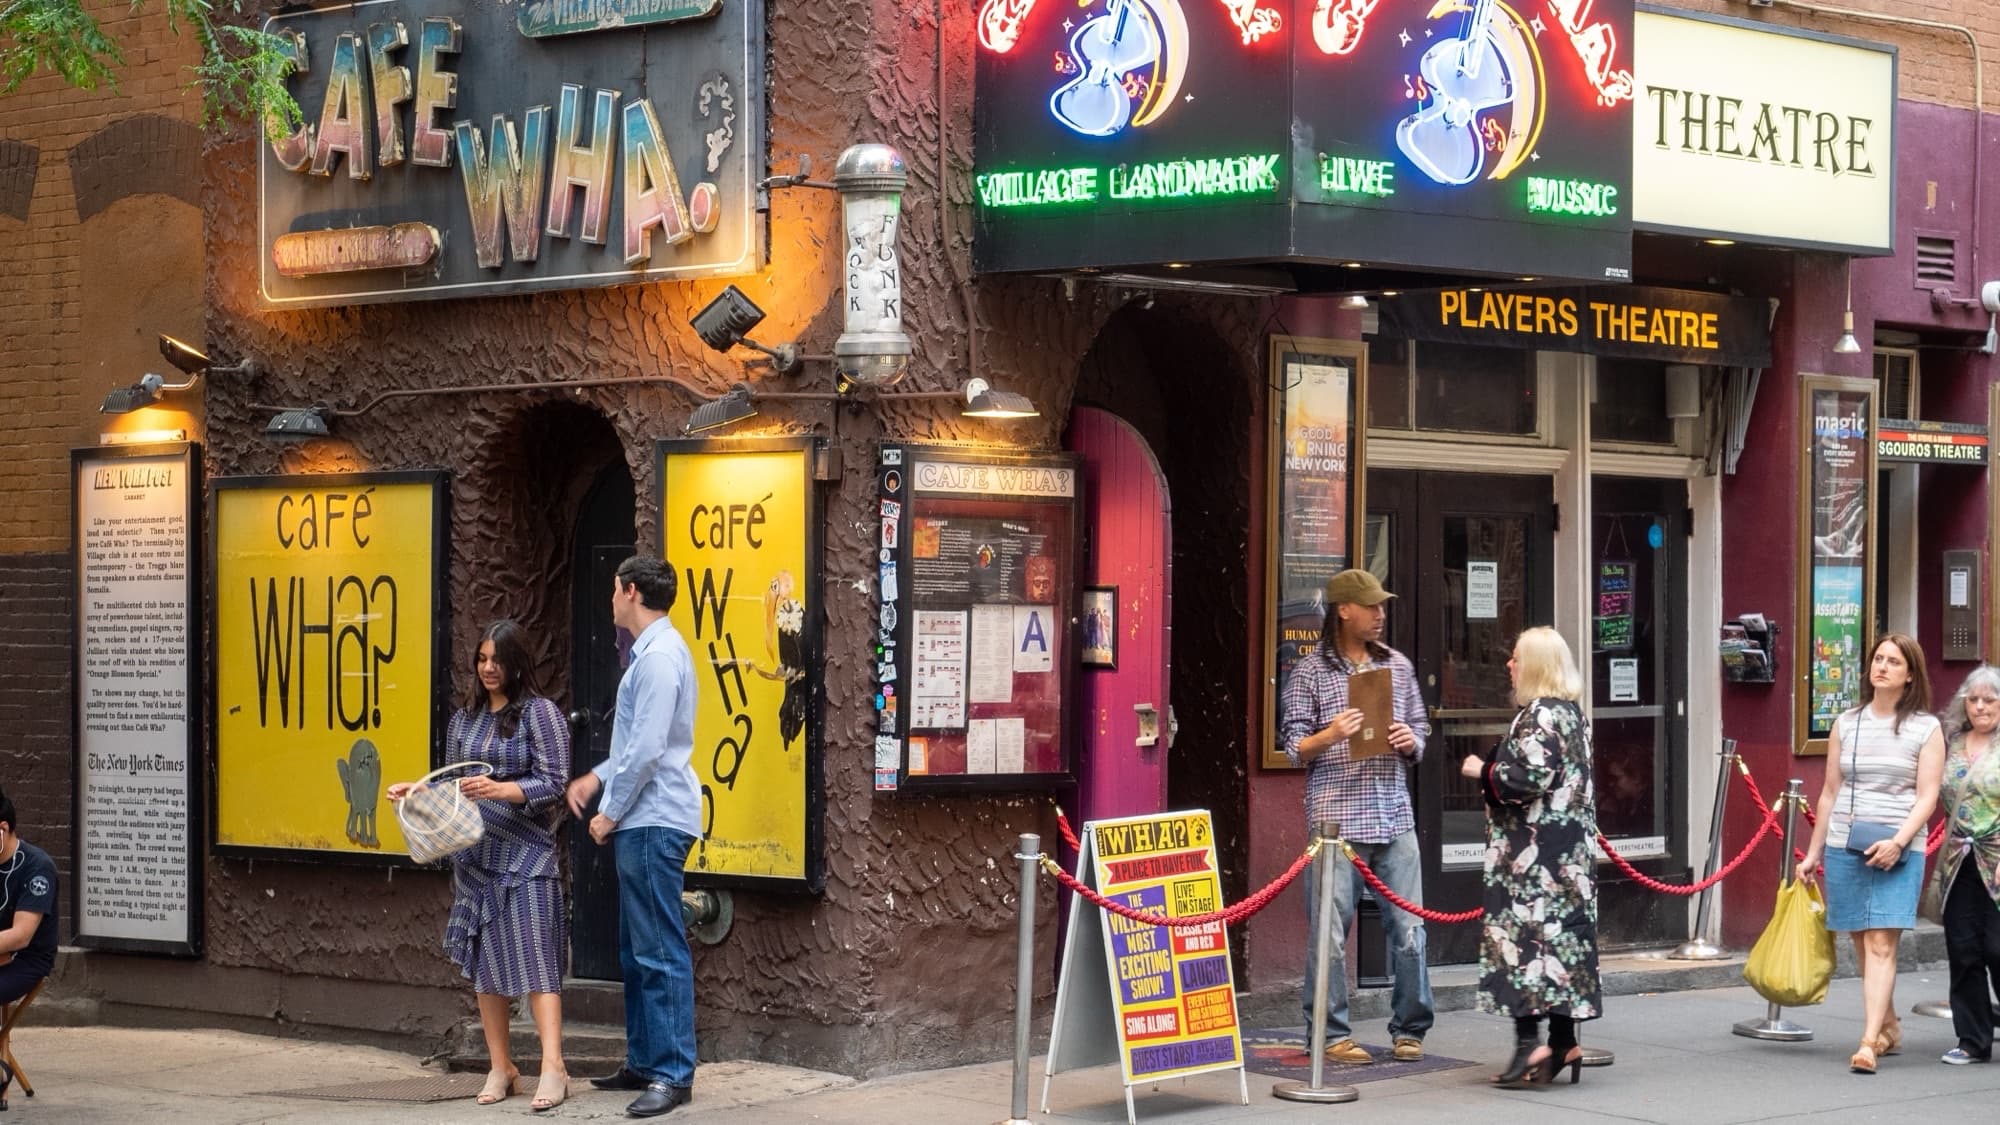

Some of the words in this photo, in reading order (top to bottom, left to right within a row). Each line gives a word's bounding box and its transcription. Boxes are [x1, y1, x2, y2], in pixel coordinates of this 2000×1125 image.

[264, 16, 464, 180] CAFE
[1647, 85, 1873, 176] THEATRE
[977, 167, 1098, 207] VILLAGE
[1110, 154, 1280, 198] LANDMARK
[1321, 156, 1395, 194] LIVE
[877, 214, 899, 319] FUNK
[1441, 290, 1578, 336] PLAYERS
[1590, 302, 1719, 349] THEATRE
[1300, 427, 1333, 440] GOOD
[1815, 412, 1865, 438] magic
[1879, 441, 1931, 457] SGOUROS
[1934, 445, 1981, 459] THEATRE
[1286, 457, 1313, 470] NEW
[1314, 458, 1346, 472] YORK
[919, 464, 989, 489] CAFE
[995, 467, 1070, 493] WHA?
[1021, 611, 1047, 652] A
[1285, 630, 1322, 641] HUMAN
[88, 752, 105, 772] The
[107, 753, 127, 771] New
[129, 754, 153, 776] York
[154, 754, 185, 772] Times
[1105, 820, 1187, 855] WHA?
[1115, 865, 1121, 881] A
[1121, 861, 1149, 880] PLACE
[1150, 858, 1162, 876] TO
[1162, 854, 1185, 873] HAVE
[1128, 894, 1143, 908] THE
[1177, 884, 1195, 899] LIVE!
[1178, 899, 1188, 914] ON
[1189, 897, 1212, 912] STAGE
[1127, 931, 1156, 954] MOST
[1185, 937, 1201, 951] AND
[1120, 949, 1170, 980] EXCITING
[1181, 959, 1227, 988] LAUGH!
[1131, 975, 1165, 1000] SHOW!
[1187, 994, 1206, 1008] EVERY
[1207, 990, 1228, 1006] FRIDAY
[1201, 1003, 1231, 1019] SATURDAY
[1126, 1015, 1146, 1036] SING
[1147, 1013, 1176, 1034] ALONG!
[1132, 1048, 1162, 1072] GUEST
[1163, 1045, 1194, 1067] STARS!
